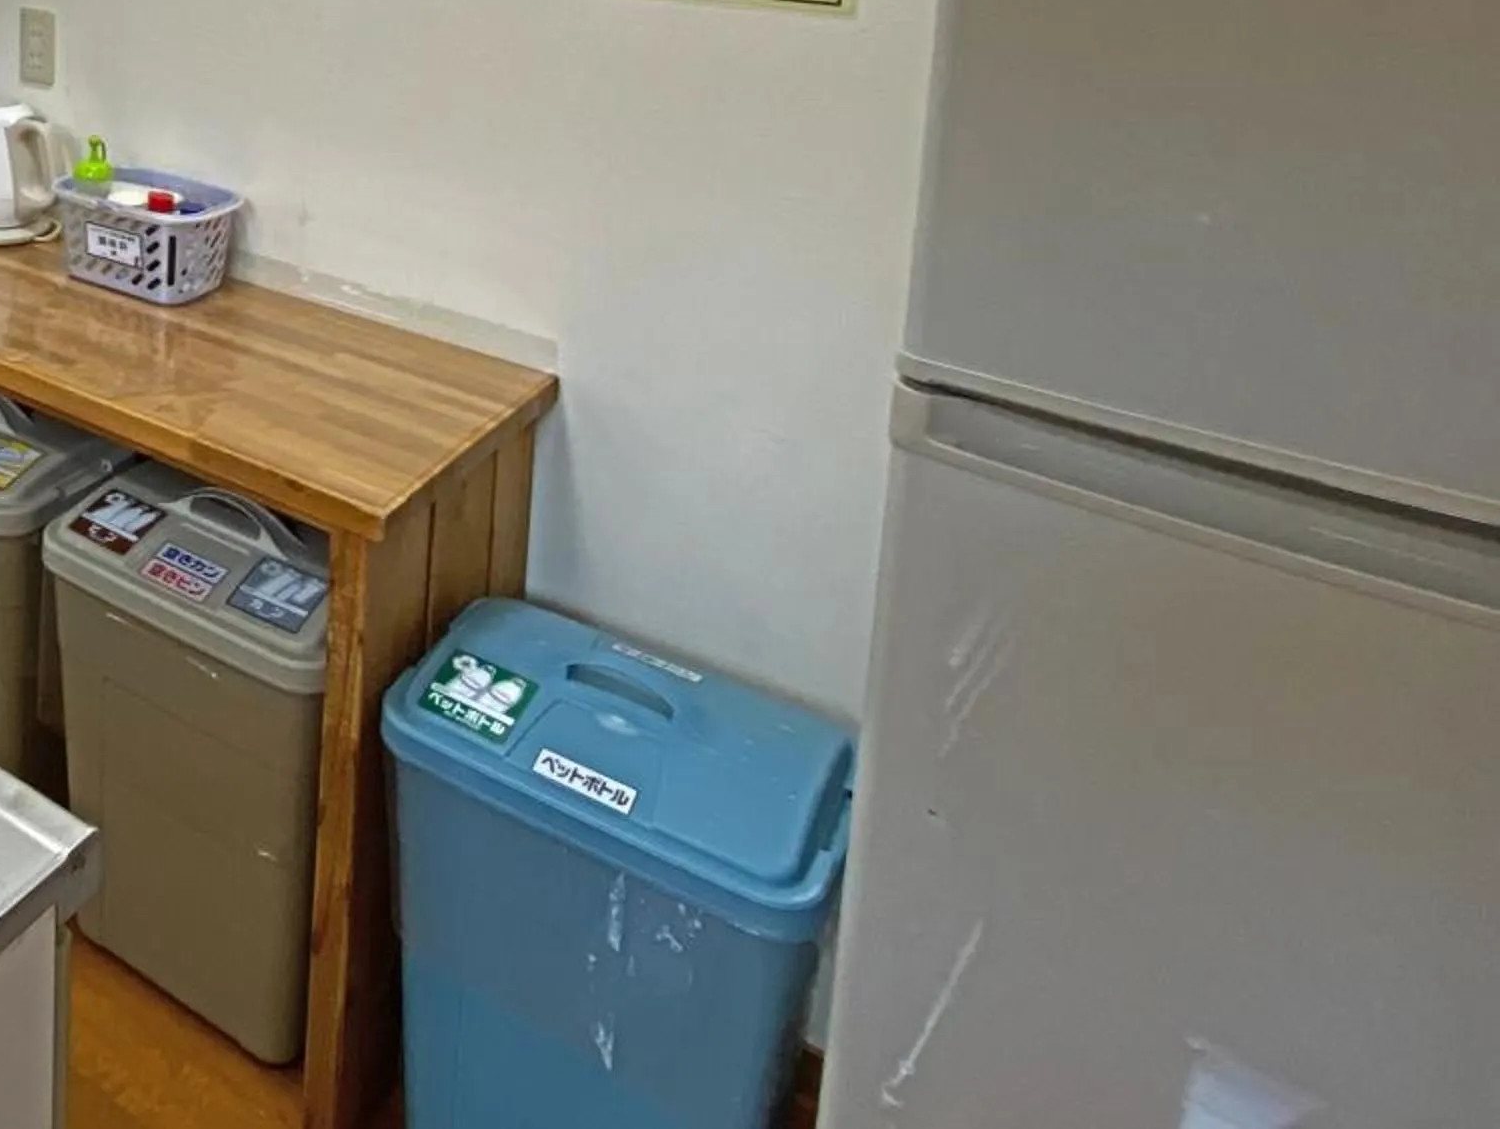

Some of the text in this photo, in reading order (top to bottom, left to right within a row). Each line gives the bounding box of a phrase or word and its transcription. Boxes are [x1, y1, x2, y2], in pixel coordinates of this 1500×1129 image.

[150, 561, 205, 596] 空きビン
[162, 546, 221, 579] 空きカン
[427, 691, 507, 737] ペットボトル
[541, 755, 631, 808] ペットボトル
